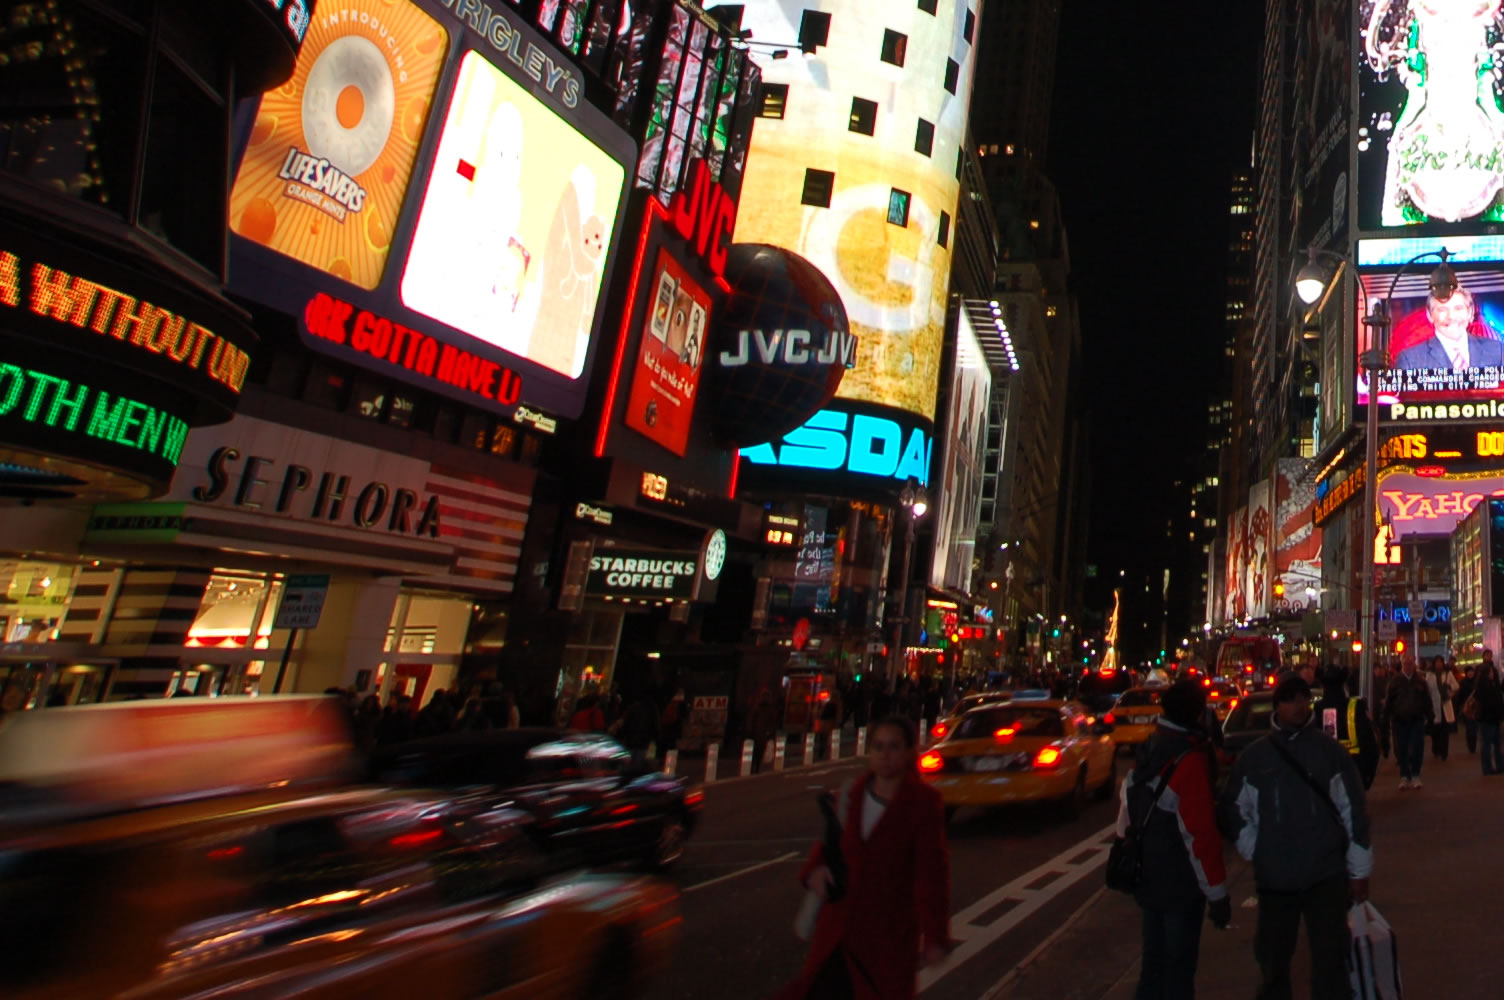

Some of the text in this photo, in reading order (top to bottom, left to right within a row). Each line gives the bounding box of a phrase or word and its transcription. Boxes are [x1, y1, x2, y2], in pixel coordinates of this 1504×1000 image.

[323, 8, 408, 83] INTRODUCING
[675, 157, 735, 284] JVC
[29, 262, 216, 370] WITHOUT
[352, 310, 438, 377] GOTTA
[719, 329, 811, 367] JVC
[87, 391, 167, 453] MEN
[738, 409, 933, 487] SDA
[192, 446, 441, 538] SEPHORA
[590, 556, 696, 576] STARBUCKS
[606, 572, 675, 589] COFFEE
